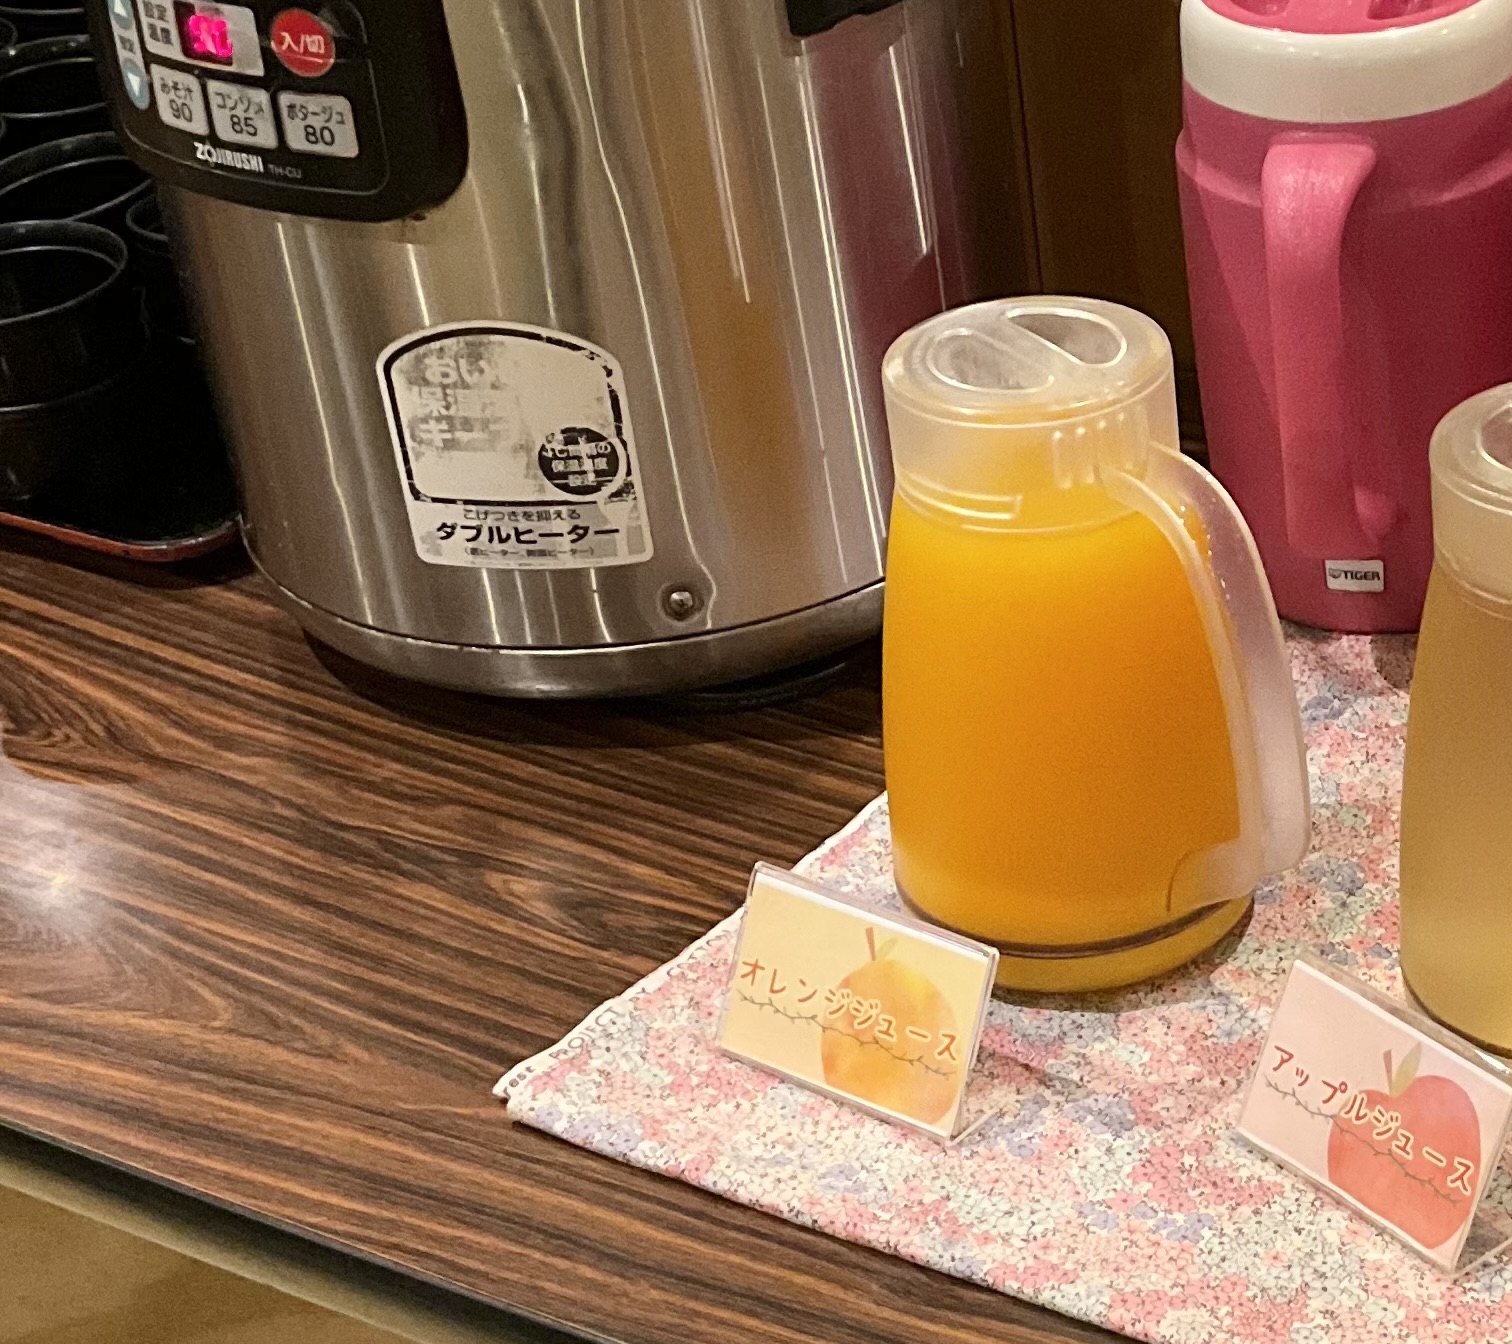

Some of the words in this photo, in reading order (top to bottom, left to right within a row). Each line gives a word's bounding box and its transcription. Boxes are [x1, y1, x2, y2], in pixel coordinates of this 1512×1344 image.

[160, 76, 194, 102] みそ汁
[169, 98, 193, 123] 90
[286, 102, 346, 125] ポタージュ
[230, 114, 258, 137] 85
[304, 124, 335, 147] 80
[193, 141, 265, 173] ZOJIRUSHI
[436, 522, 620, 545] ダブルヒーター
[1343, 570, 1381, 581] TIGER
[740, 958, 959, 1062] オレンジジュース
[1271, 1044, 1474, 1196] アップルジュース
